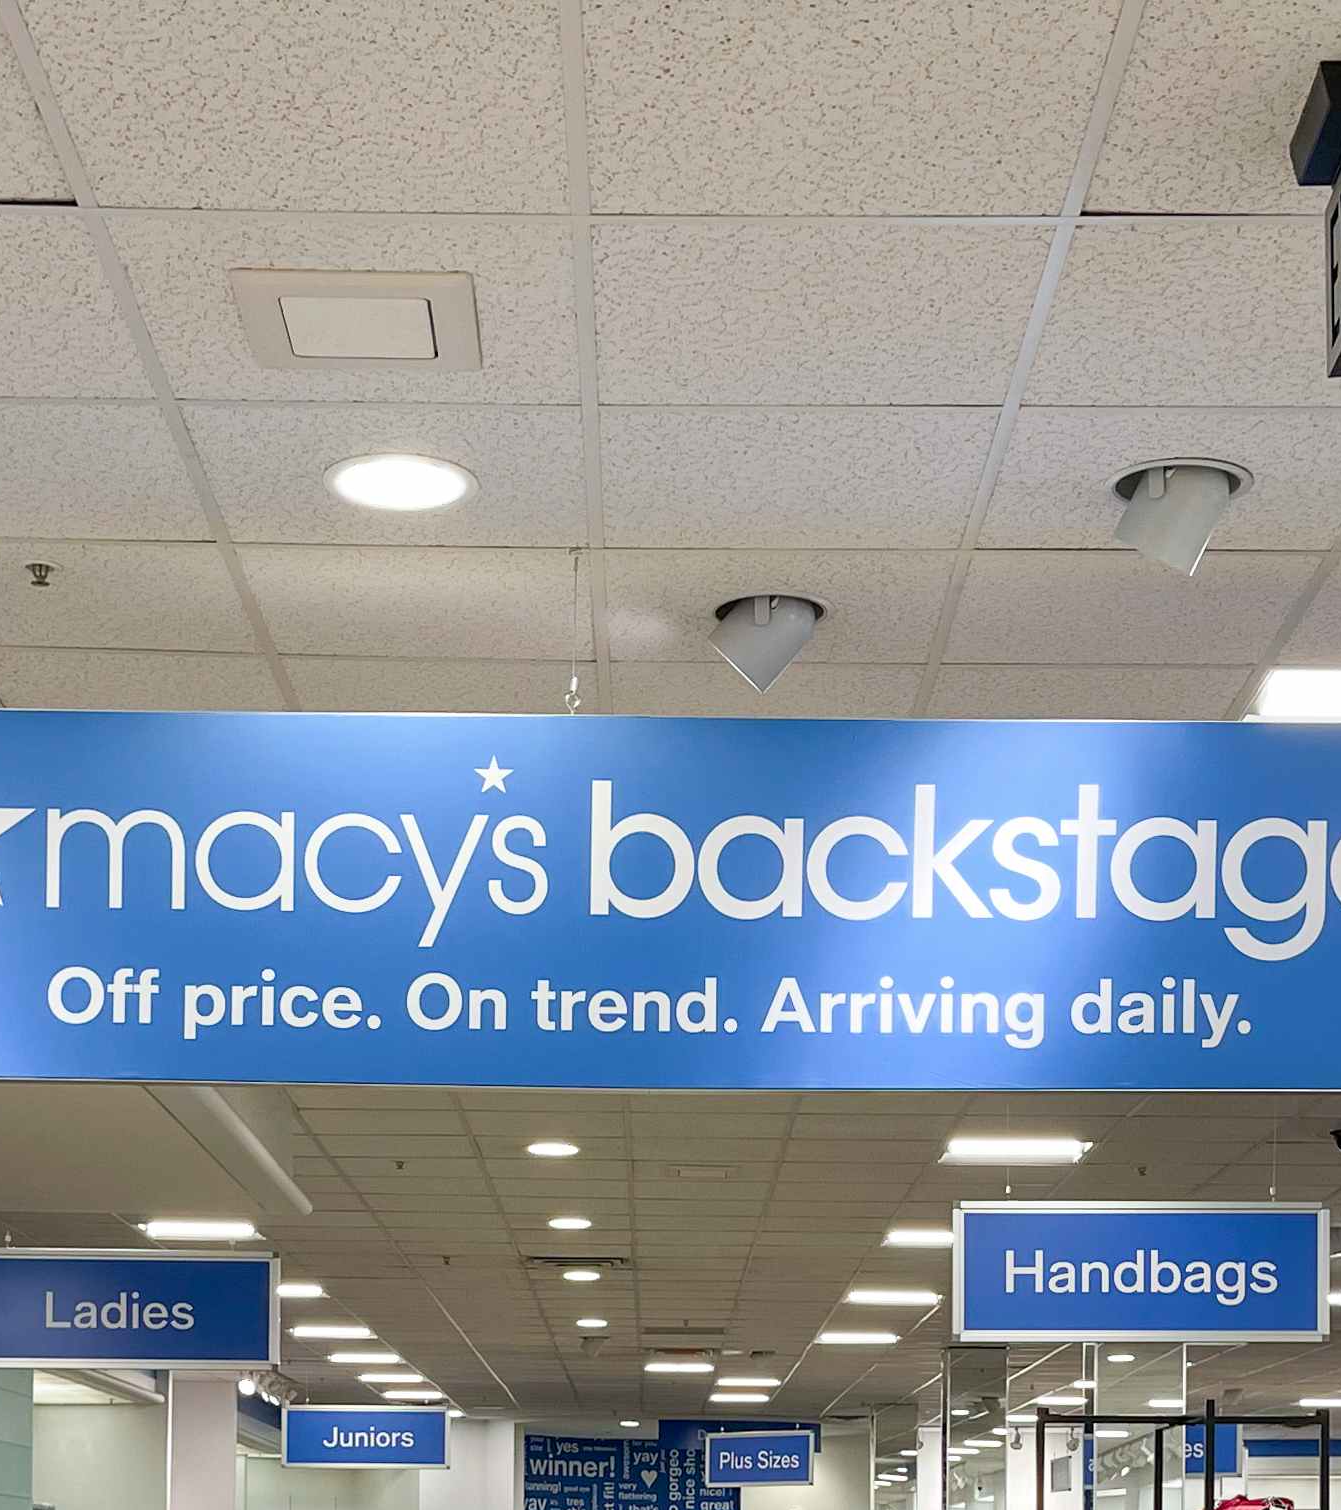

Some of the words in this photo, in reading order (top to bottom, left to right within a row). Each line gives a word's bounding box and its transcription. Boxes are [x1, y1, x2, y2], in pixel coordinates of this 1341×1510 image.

[46, 965, 160, 1026] Off
[182, 967, 382, 1041] price.
[405, 971, 508, 1031] On
[529, 976, 739, 1034] trend.
[760, 974, 1046, 1050] Arriving
[1069, 975, 1252, 1049] daily.
[1004, 1248, 1279, 1307] Handbags
[44, 1290, 195, 1331] Ladies
[322, 1425, 415, 1449] Juniors
[556, 1441, 579, 1455] yes
[529, 1453, 616, 1478] winner!
[632, 1451, 659, 1467] yay
[719, 1451, 753, 1470] Plus
[756, 1450, 800, 1470] Sizes
[683, 1478, 696, 1510] nice
